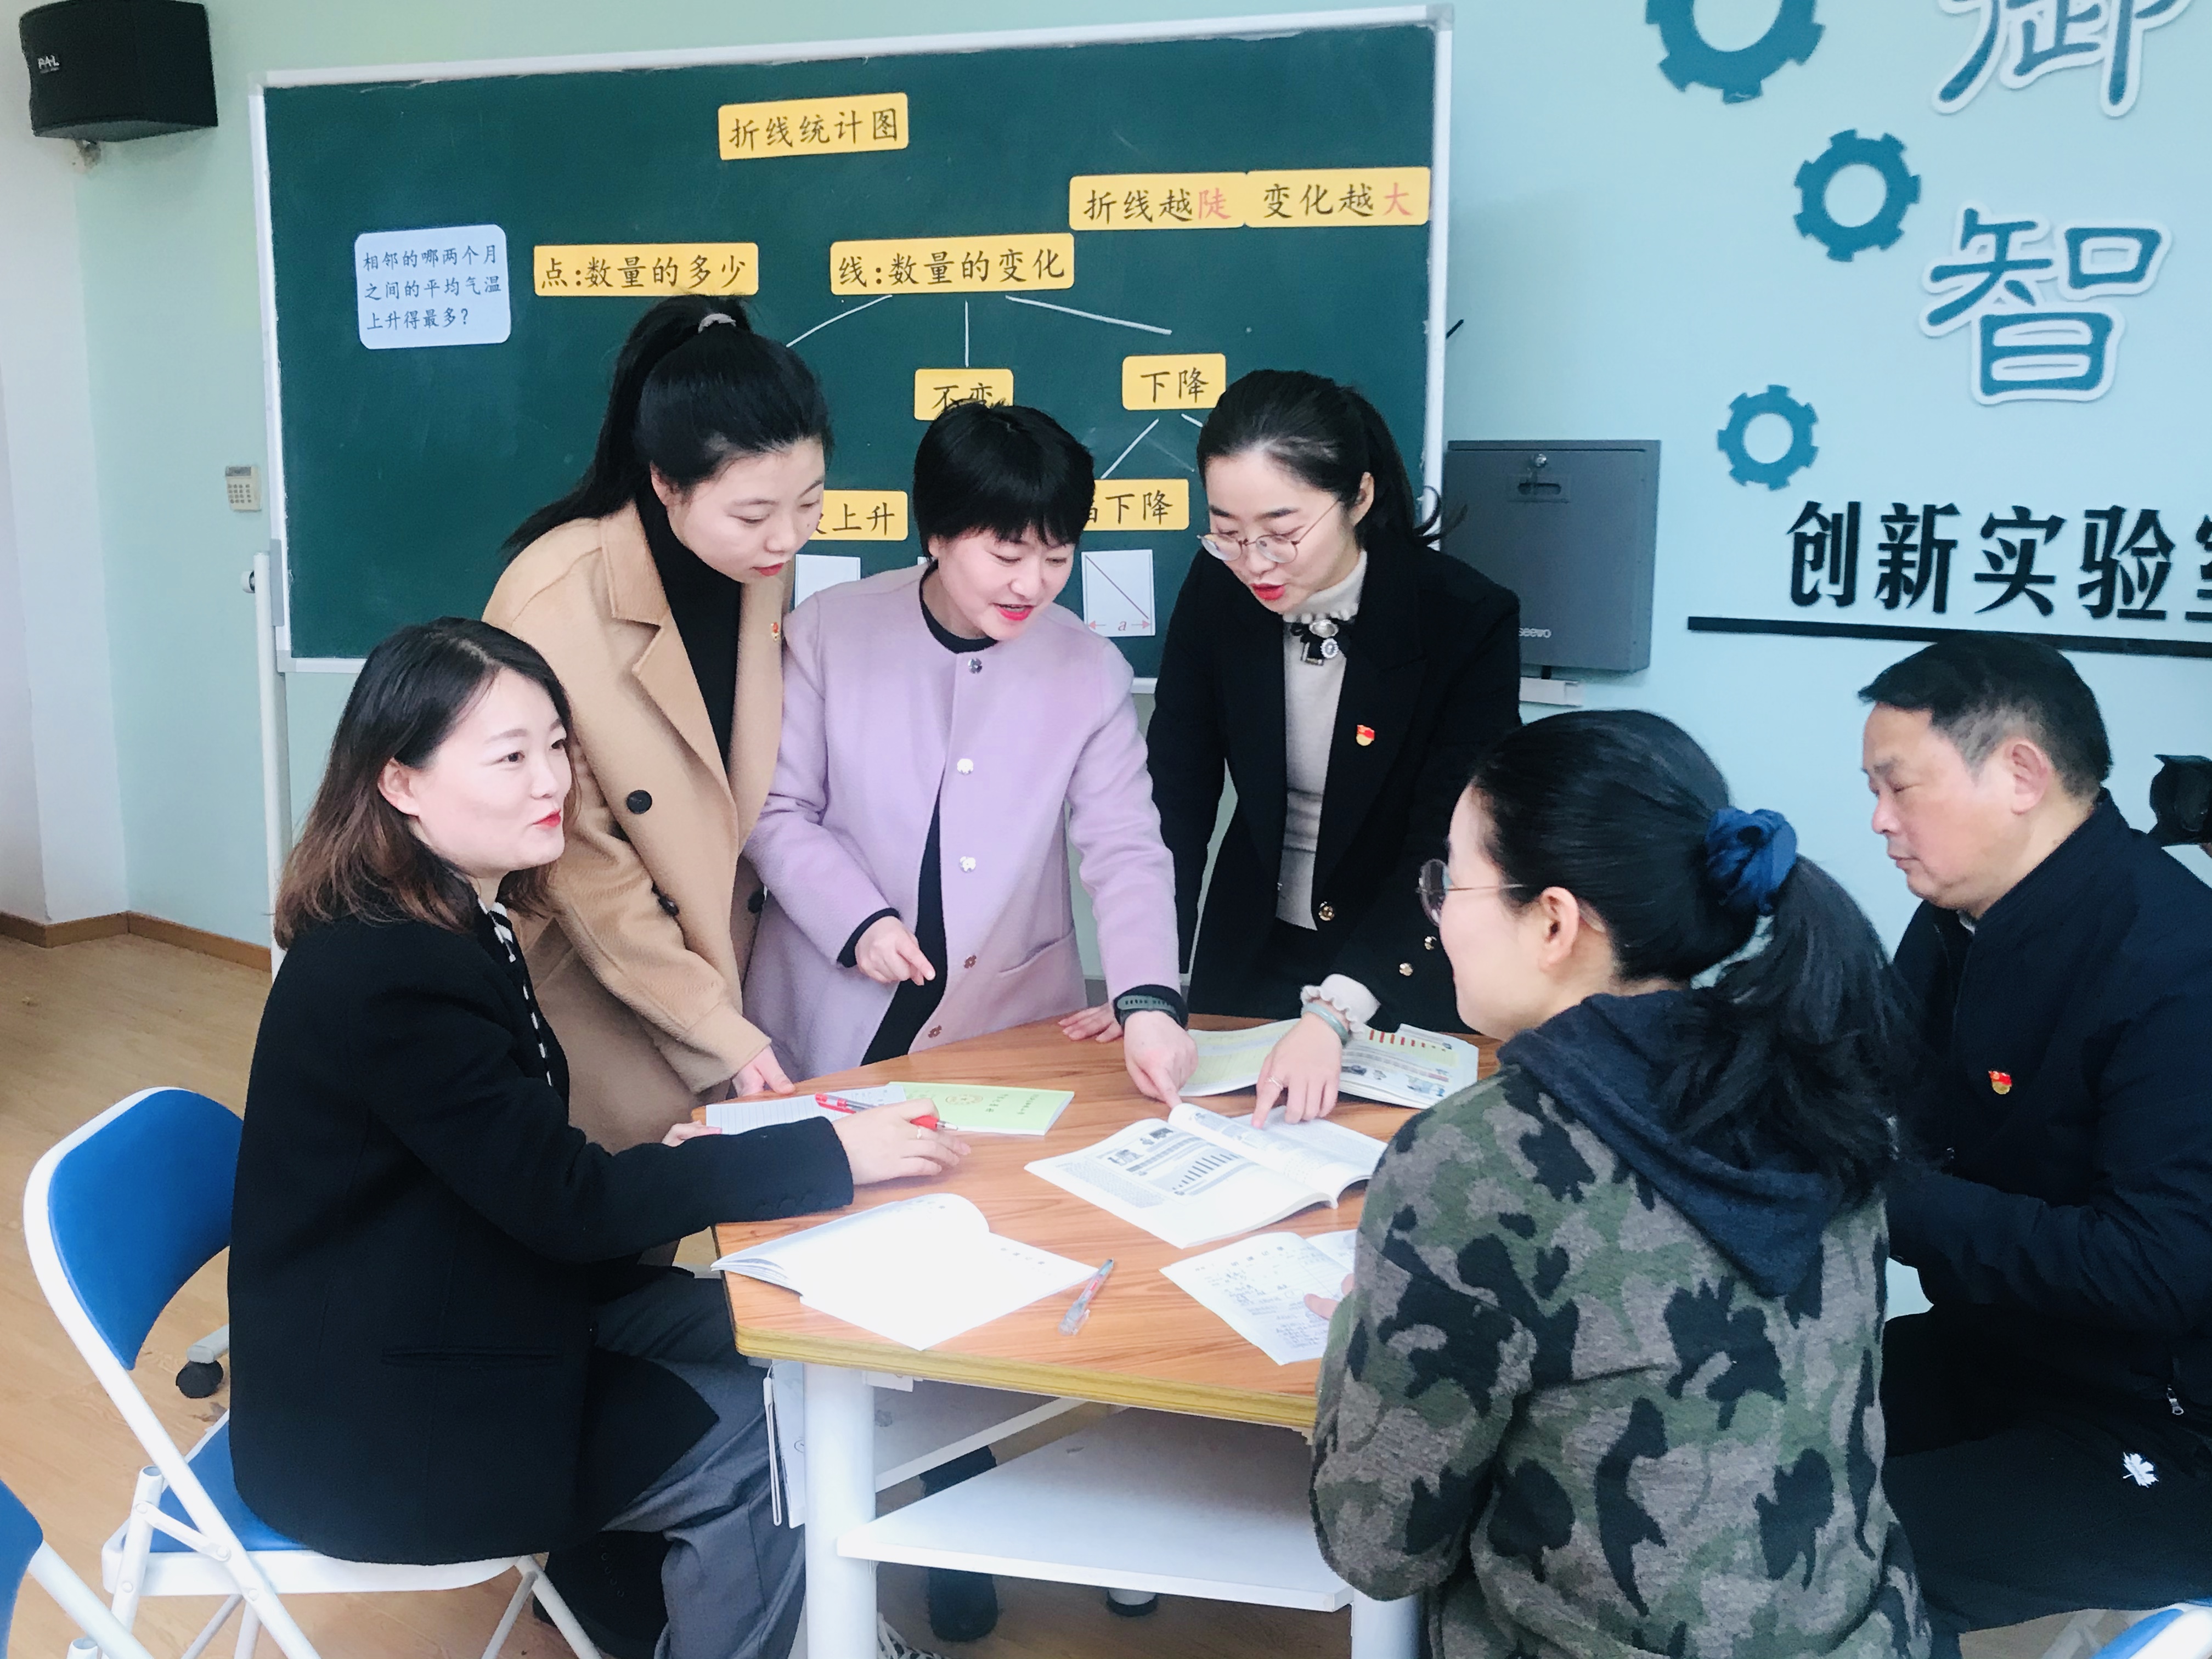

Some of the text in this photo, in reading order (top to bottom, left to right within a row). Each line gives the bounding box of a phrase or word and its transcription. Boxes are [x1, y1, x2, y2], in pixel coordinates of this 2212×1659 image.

[729, 108, 898, 151] 折线统计图
[1084, 182, 1413, 224] 折线越陡 变化越大
[363, 245, 496, 272] 相邻的哪两个月
[541, 254, 746, 289] 点:数量的多少
[838, 248, 1065, 288] 线:数量的变化
[364, 275, 502, 301] 之间的平均气温
[366, 307, 469, 330] 上升得最多?
[1140, 366, 1209, 404] 下降
[815, 501, 895, 536] 上升
[1786, 500, 2212, 622] 创新实验
